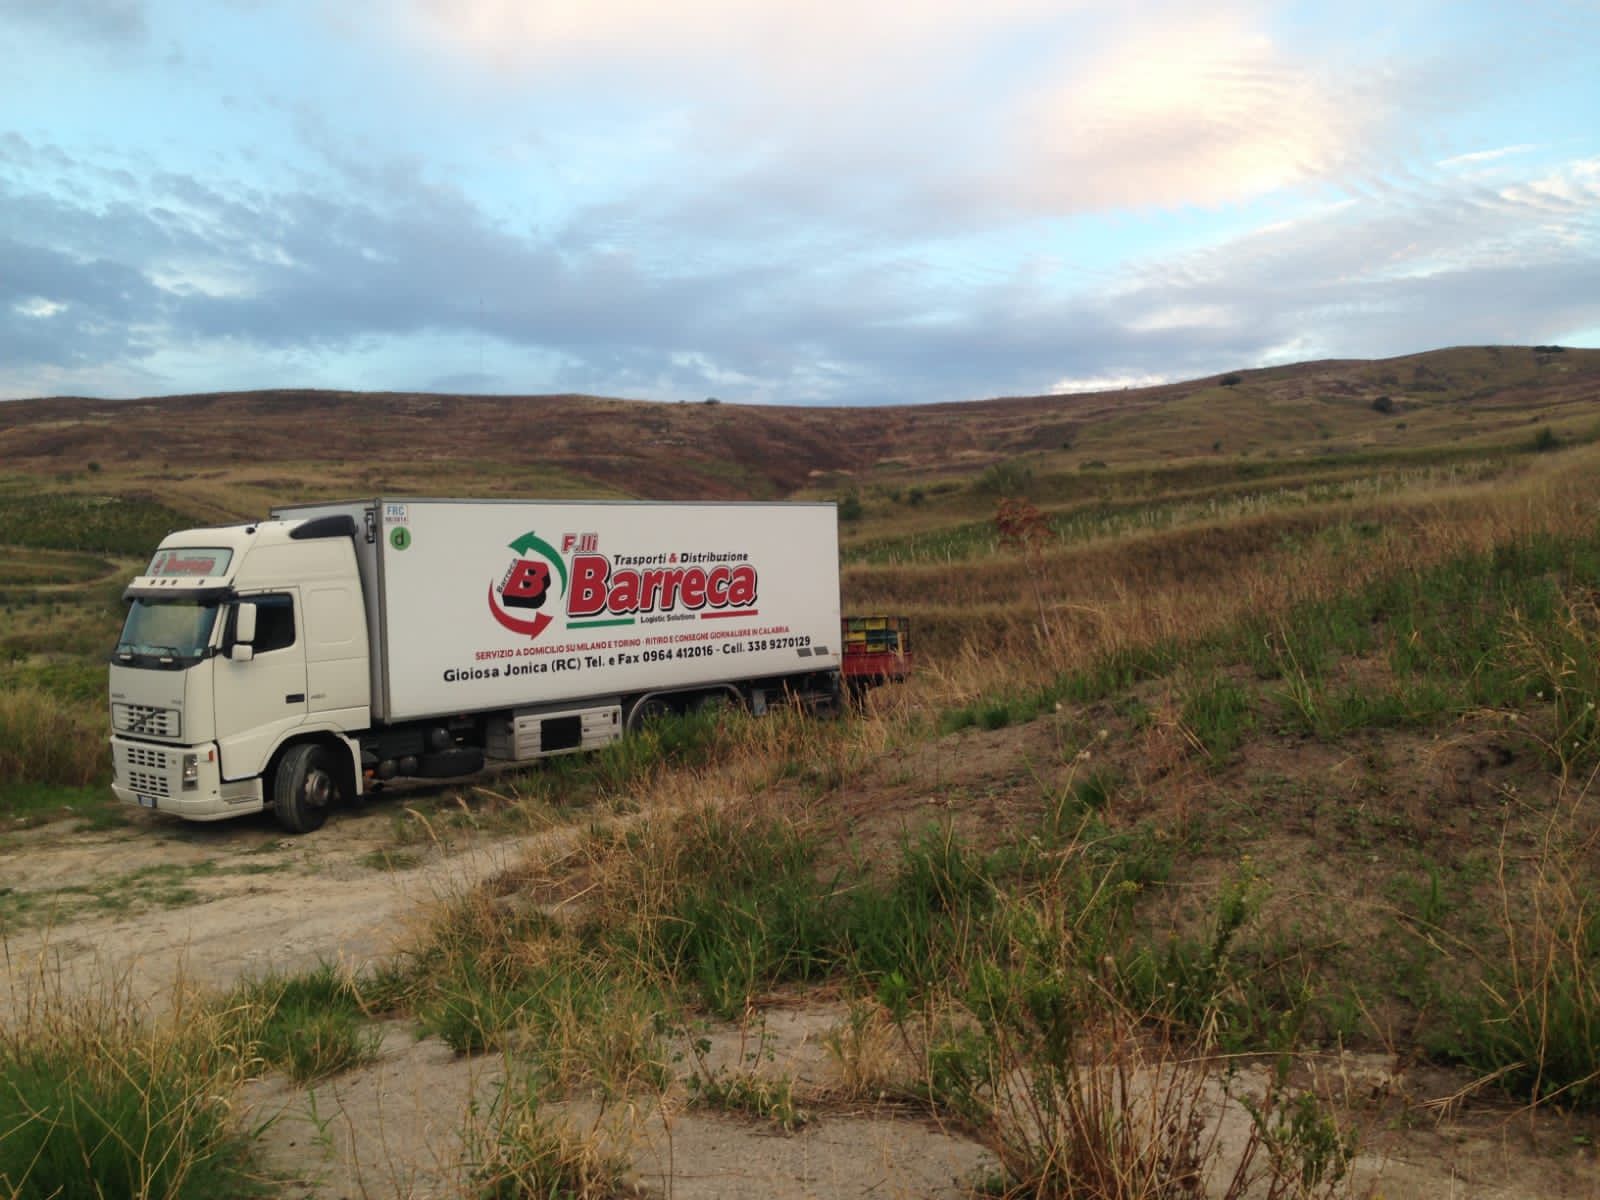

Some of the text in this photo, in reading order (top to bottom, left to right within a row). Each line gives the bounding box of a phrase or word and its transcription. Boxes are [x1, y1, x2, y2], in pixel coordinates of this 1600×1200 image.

[387, 505, 405, 516] FRC
[561, 533, 598, 554] F.lli
[613, 551, 749, 566] Trasporti & Distribuzione
[502, 559, 552, 610] B
[566, 554, 758, 618] Barreca
[640, 613, 696, 624] Logistic Solutions
[475, 625, 790, 661] SERVIZIO A DOMICILIO SU MILANO E TORINO RITIRO E CONSEGNE GIORNALIERE IN CALABRIA
[443, 666, 500, 682] Gioiosa
[503, 662, 548, 677] Jonica
[551, 658, 581, 672] (RC)
[584, 655, 606, 668] Tel.
[608, 657, 615, 666] e
[618, 653, 640, 665] Fax
[643, 649, 673, 663] 0964
[676, 645, 713, 659] 412016
[722, 642, 745, 655] Cell.
[747, 639, 767, 652] 338
[770, 636, 811, 650] 9270129
